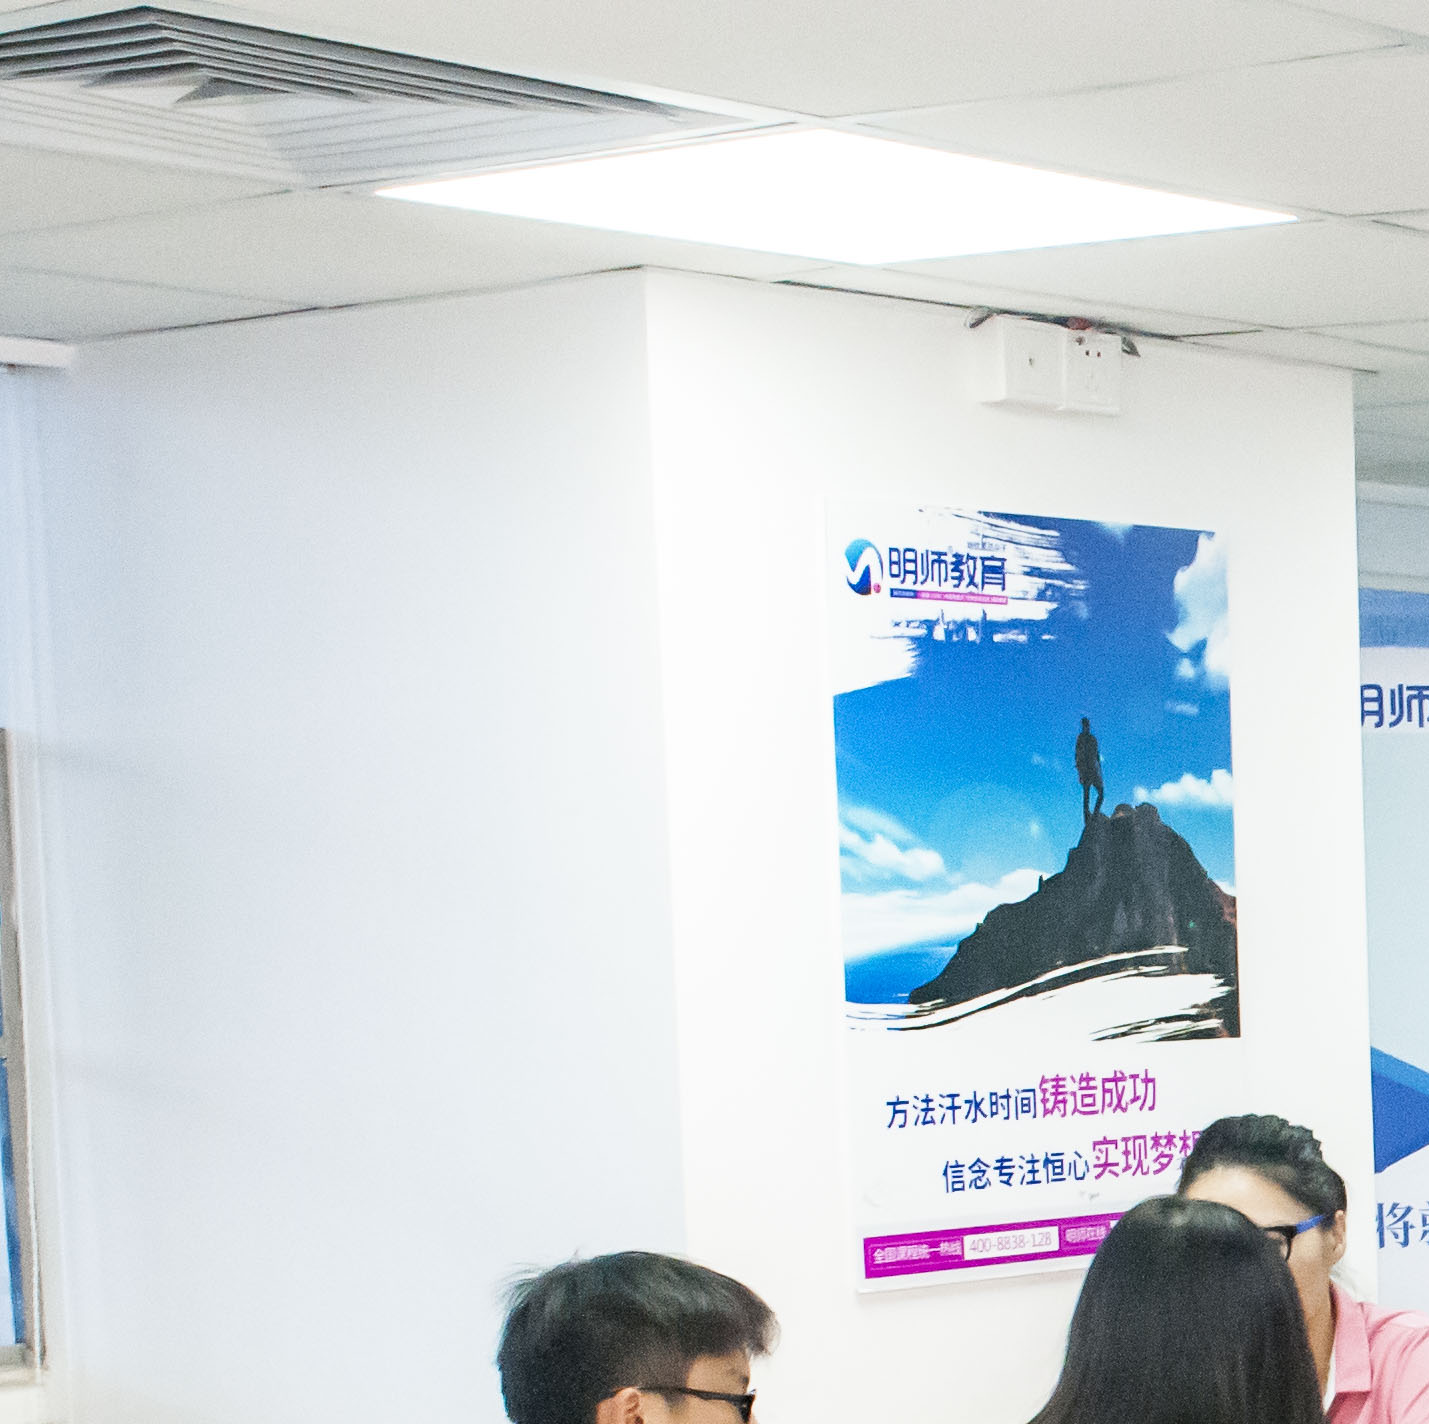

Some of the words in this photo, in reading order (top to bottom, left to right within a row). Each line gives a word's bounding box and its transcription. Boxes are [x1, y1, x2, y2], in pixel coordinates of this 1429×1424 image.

[888, 546, 1007, 591] 明师教育
[886, 1069, 1156, 1129] 方法汗水时间铸造成功
